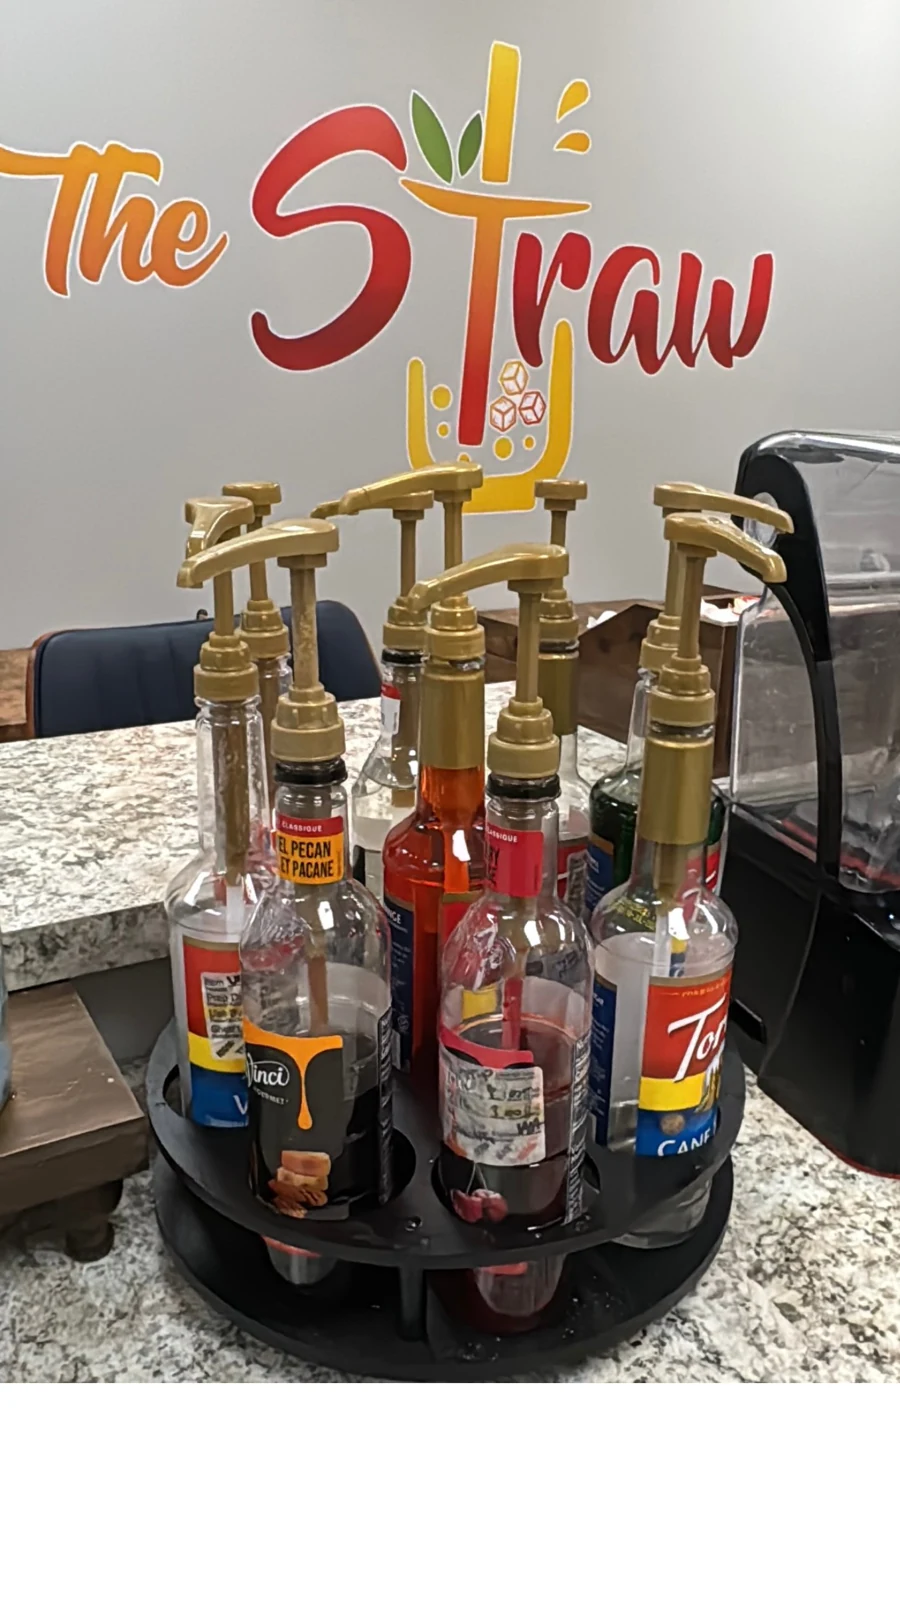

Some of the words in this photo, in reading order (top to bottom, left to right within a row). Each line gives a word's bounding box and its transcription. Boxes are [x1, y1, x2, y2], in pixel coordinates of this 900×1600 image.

[0, 141, 228, 297] The
[281, 820, 323, 833] CLASSIQUE
[291, 840, 331, 859] PECAN
[292, 860, 334, 878] PACANE
